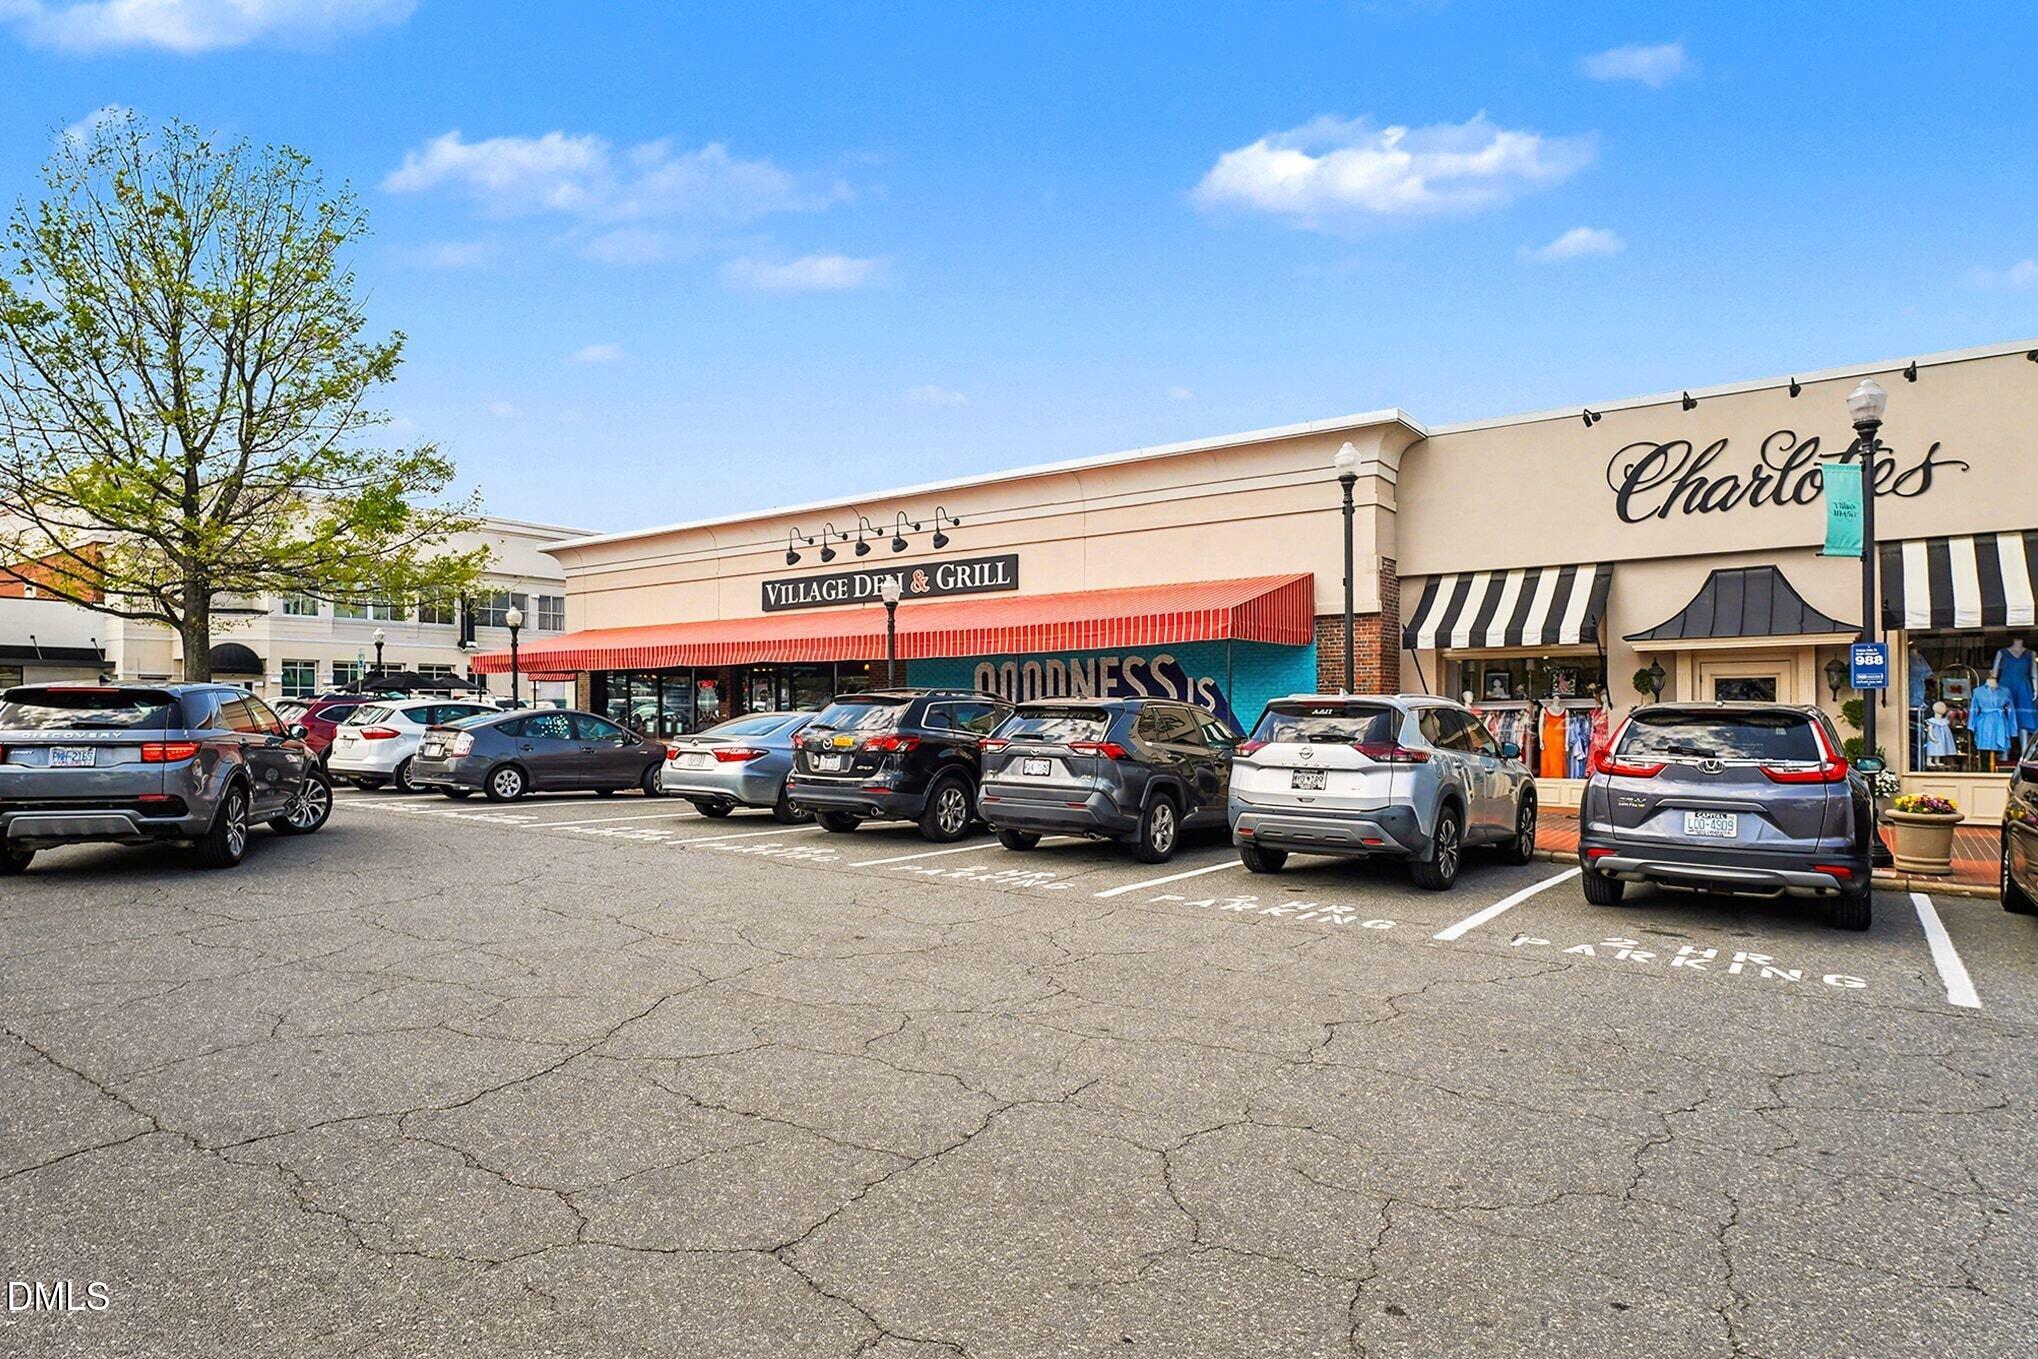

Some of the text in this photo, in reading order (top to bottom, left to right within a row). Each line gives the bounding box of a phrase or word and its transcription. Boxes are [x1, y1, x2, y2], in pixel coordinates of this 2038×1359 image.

[1607, 430, 1969, 523] Charloes
[766, 561, 1011, 605] VILLAGE DEI & GRILL
[1855, 655, 1884, 666] 988
[889, 865, 1075, 890] PARKING
[1149, 894, 1396, 930] PARKING
[1509, 936, 1868, 989] PARKING
[1600, 937, 1774, 966] 2 HR
